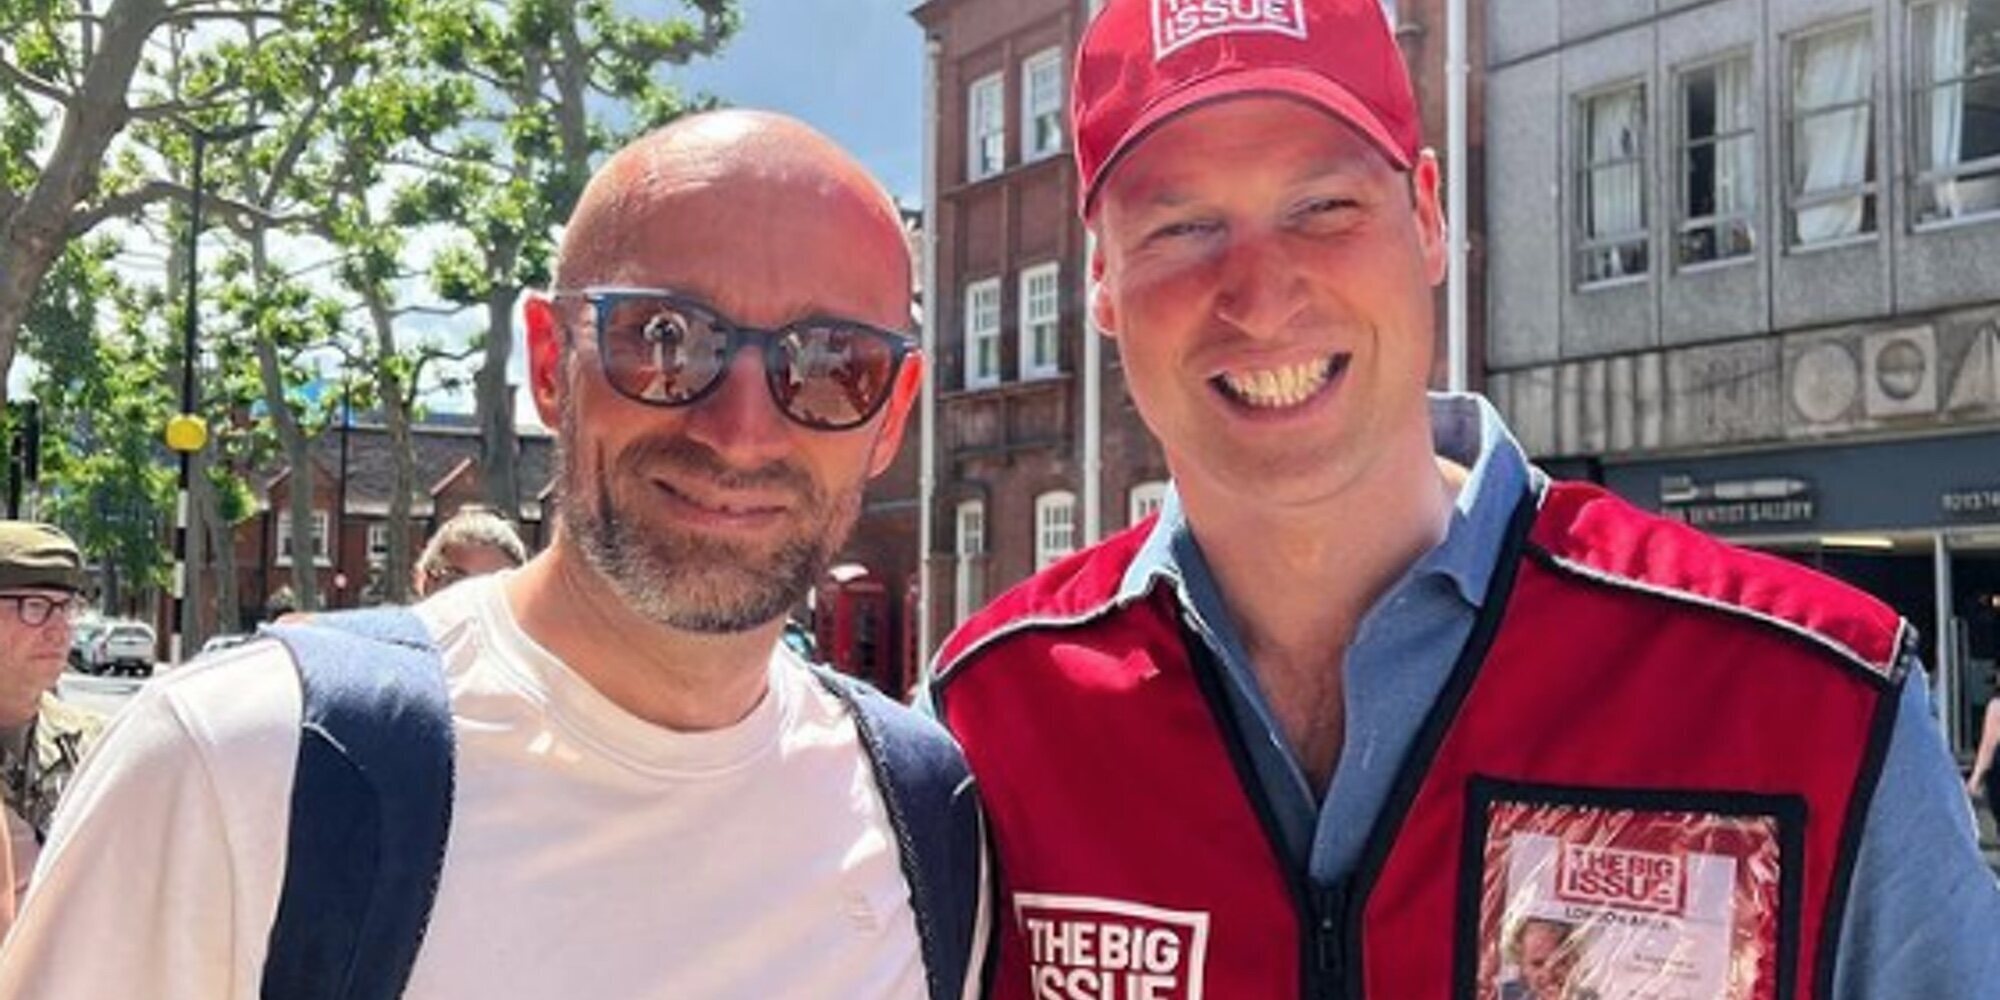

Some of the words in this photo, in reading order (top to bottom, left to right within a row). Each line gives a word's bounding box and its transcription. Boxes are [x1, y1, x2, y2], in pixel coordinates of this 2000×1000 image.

[1166, 0, 1290, 42] ISSUE
[1628, 854, 1675, 880] BIG
[1027, 918, 1097, 967] THE
[1100, 923, 1181, 973] BIG
